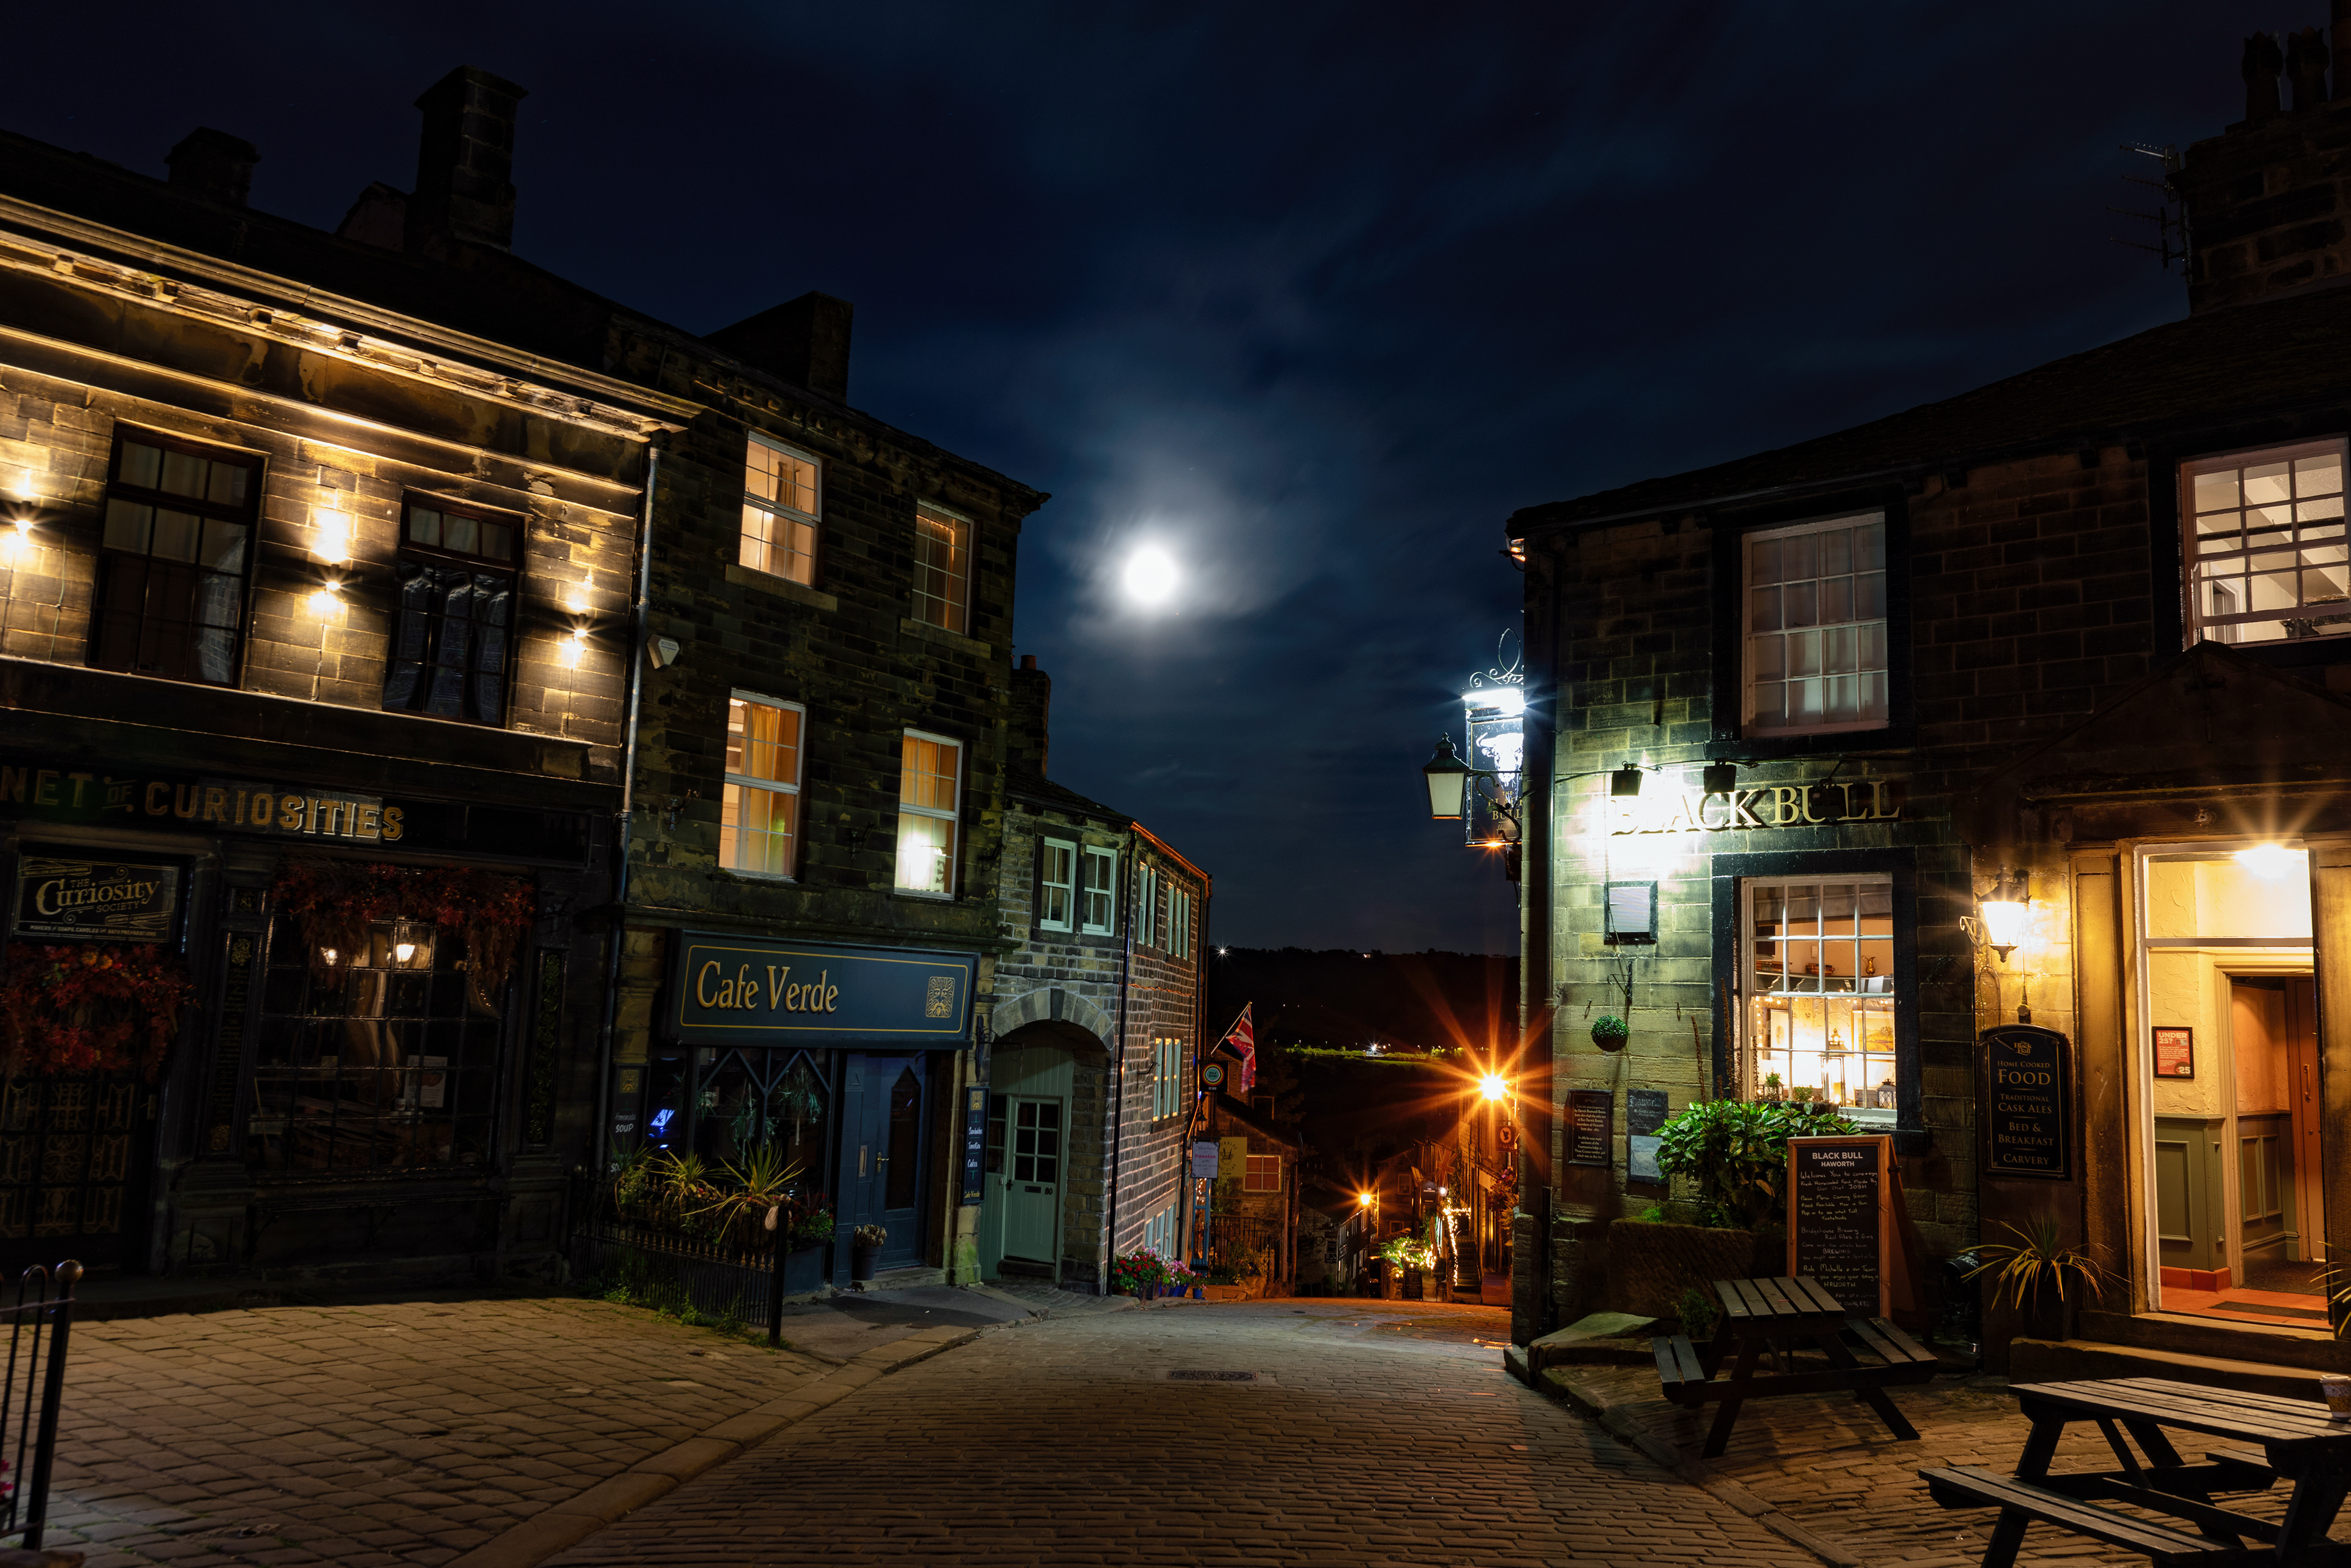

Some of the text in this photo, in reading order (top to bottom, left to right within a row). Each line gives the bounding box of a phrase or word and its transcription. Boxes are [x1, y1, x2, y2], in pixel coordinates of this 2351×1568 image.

[107, 785, 133, 804] OF
[145, 782, 404, 841] CURIOSITIES
[1611, 781, 1900, 835] BACK BULL
[70, 879, 90, 888] THE
[36, 879, 160, 916] Curiosity
[96, 900, 140, 913] SOCIETY
[697, 960, 839, 1013] Cafe Verde
[1998, 1069, 2050, 1085] FOOD
[2000, 1093, 2050, 1102] TRADITIONAL
[1998, 1103, 2052, 1114] CASK ALES
[615, 1123, 634, 1133] SOUP
[2009, 1122, 2042, 1132] BED &
[1998, 1134, 2055, 1146] BREAKFAST
[967, 1159, 978, 1168] Cakes
[2003, 1153, 2049, 1165] CARVERY
[1801, 1226, 1834, 1235] Bridgehouse
